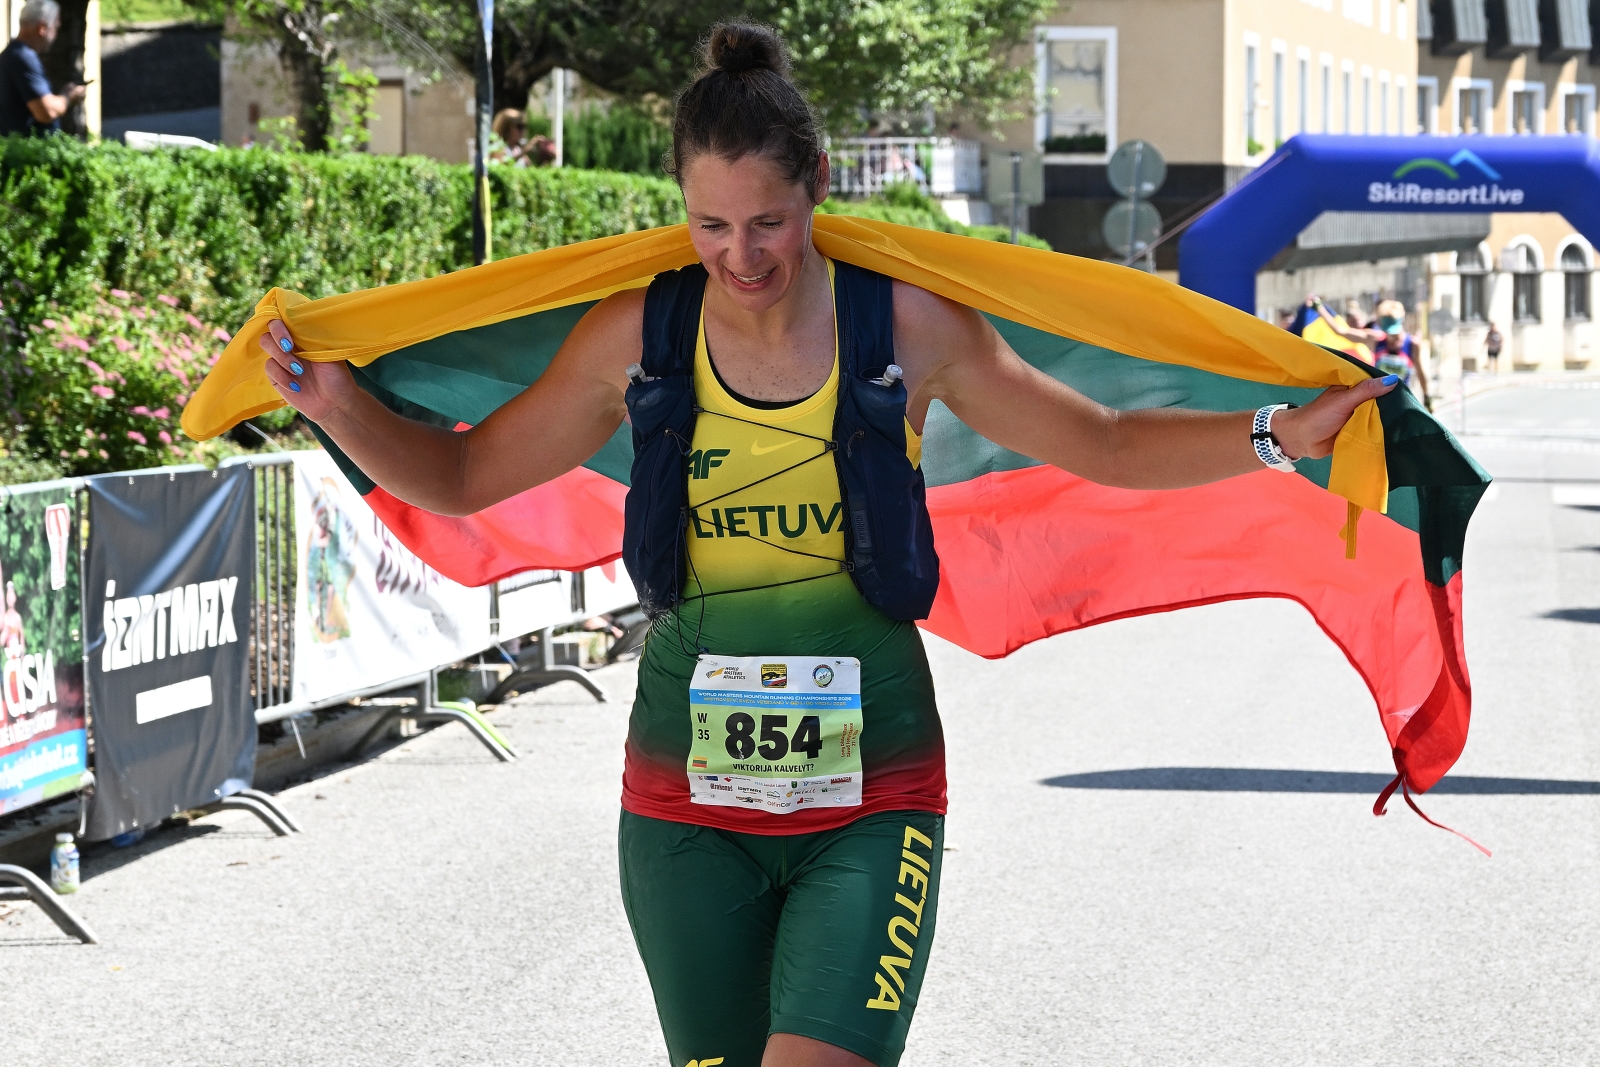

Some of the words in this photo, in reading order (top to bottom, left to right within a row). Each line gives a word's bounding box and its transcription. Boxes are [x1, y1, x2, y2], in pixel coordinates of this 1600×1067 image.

[1368, 182, 1525, 205] SkiResortLive
[697, 713, 707, 723] W
[698, 729, 709, 740] 35
[725, 712, 823, 761] 854
[732, 763, 772, 773] VIKTORIJA
[774, 763, 815, 773] KALVELYT?
[866, 825, 933, 1011] LIETUVA
